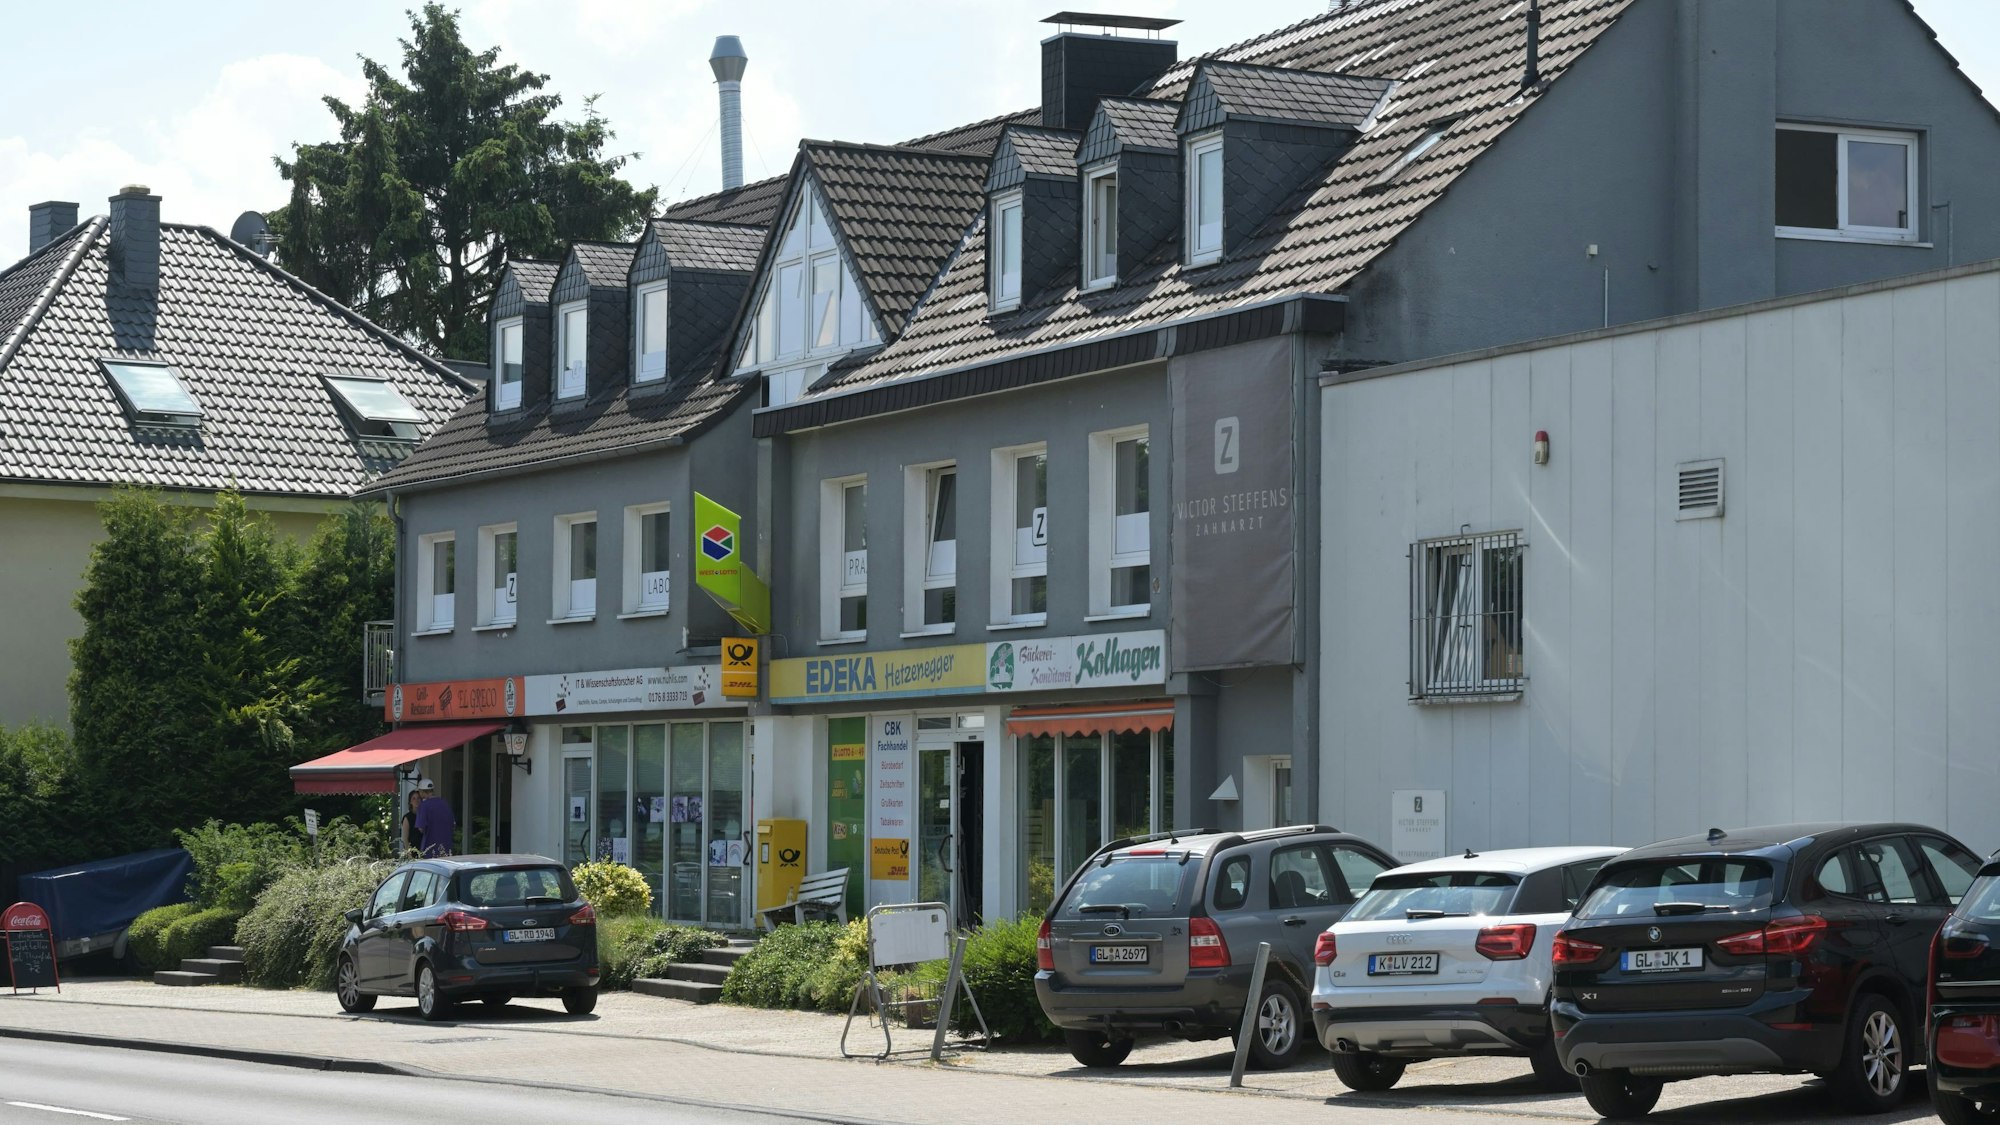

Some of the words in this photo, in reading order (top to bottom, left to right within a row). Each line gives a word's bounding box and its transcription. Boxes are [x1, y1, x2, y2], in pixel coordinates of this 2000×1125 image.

[1220, 426, 1232, 464] Z
[1177, 497, 1216, 520] VICTOR
[1223, 487, 1287, 514] STEFFENS
[1036, 512, 1044, 538] Z
[1196, 516, 1263, 536] ZAHNARZT
[508, 577, 515, 597] Z
[1075, 636, 1160, 685] Kolhagen
[576, 680, 580, 688] IT
[581, 679, 585, 688] &
[586, 676, 635, 688] Wissenschaftsforscher
[636, 675, 643, 685] AG
[806, 656, 876, 694] EDEKA
[885, 654, 954, 690] Hetzenegger
[1030, 665, 1072, 686] Konditorei
[470, 688, 496, 714] GRECO
[648, 692, 661, 702] 0176
[666, 691, 678, 701] 3333
[410, 702, 435, 715] Restaurant
[884, 720, 901, 736] CBK
[878, 740, 908, 751] Fachhandel
[874, 846, 890, 855] Deutsche
[889, 866, 908, 876] DHL
[509, 931, 519, 940] GL
[536, 929, 553, 938] 1948
[1097, 949, 1108, 960] GL
[1115, 948, 1120, 960] A
[1122, 948, 1145, 960] 2697
[1635, 953, 1652, 968] GL
[1662, 952, 1679, 966] JK
[1682, 951, 1690, 965] 1
[1379, 957, 1387, 970] K
[1394, 956, 1409, 970] LV
[1410, 956, 1432, 969] 212
